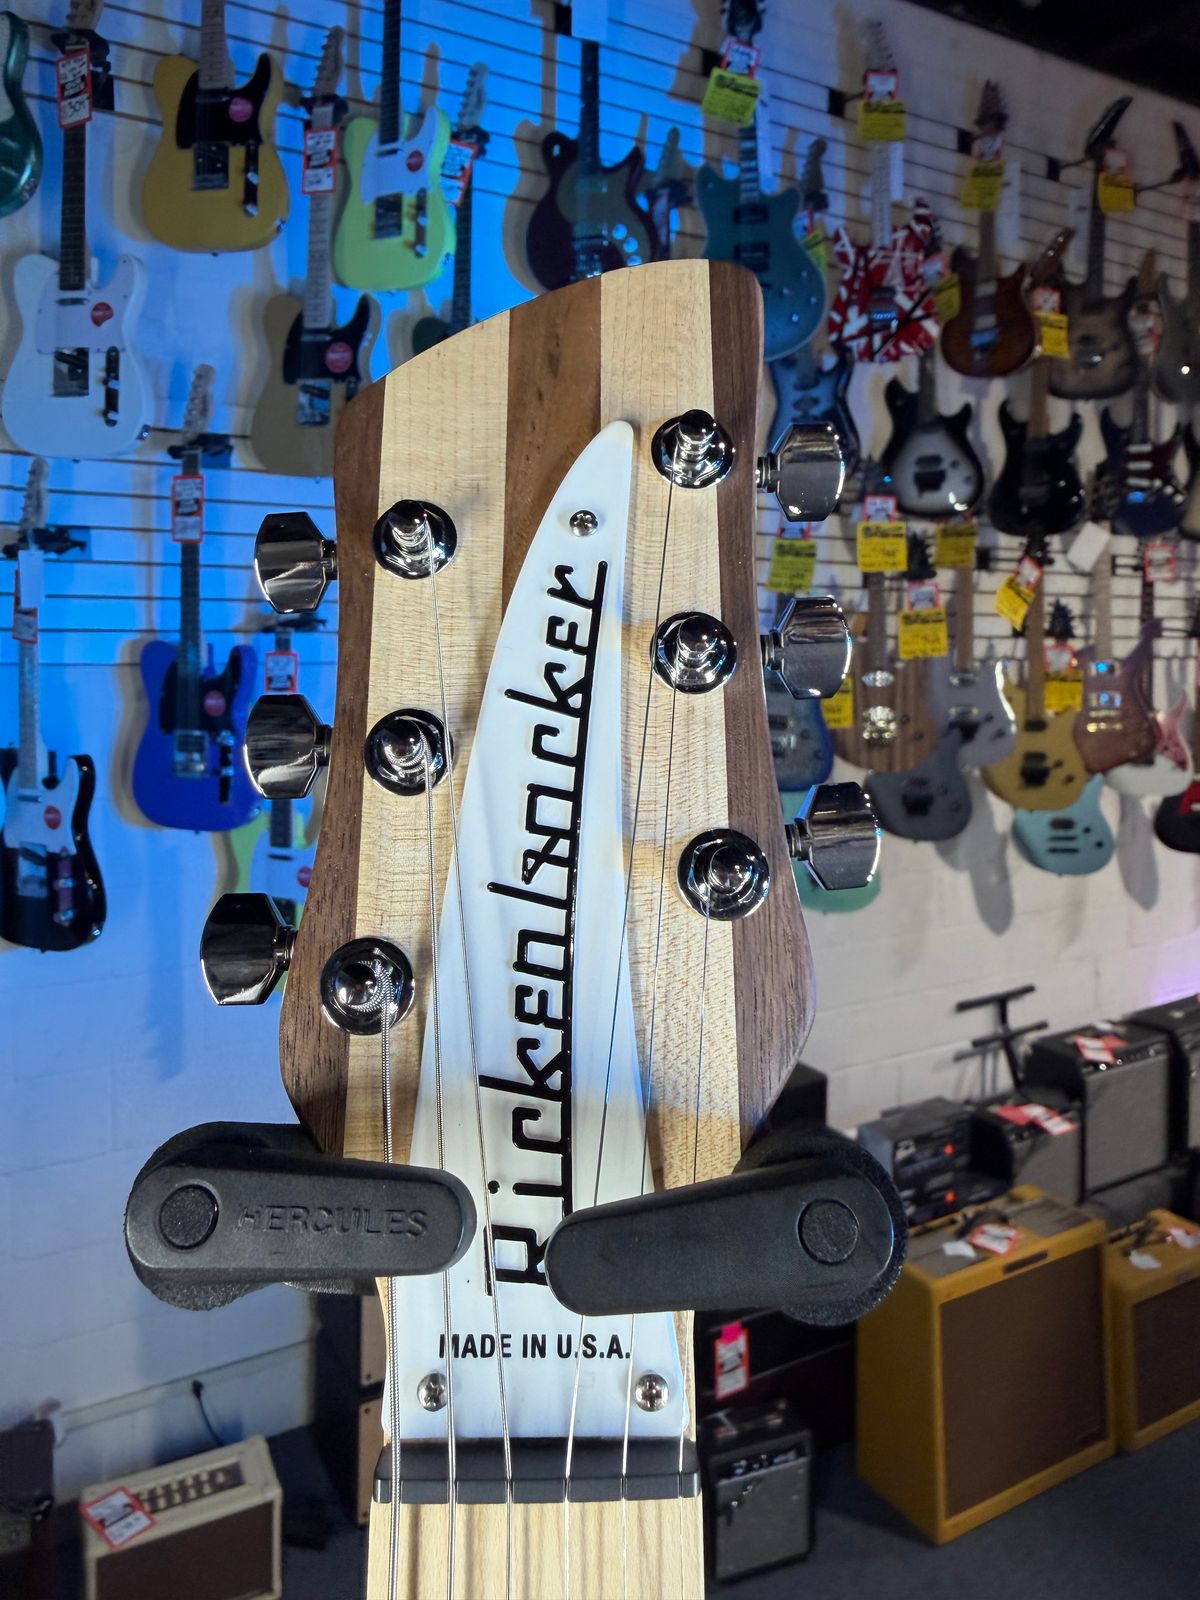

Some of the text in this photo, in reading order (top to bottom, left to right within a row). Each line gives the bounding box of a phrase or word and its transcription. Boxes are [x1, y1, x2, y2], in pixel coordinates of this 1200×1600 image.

[234, 1204, 428, 1237] HERCULES
[438, 1333, 631, 1359] MADE IN U.S.A.
